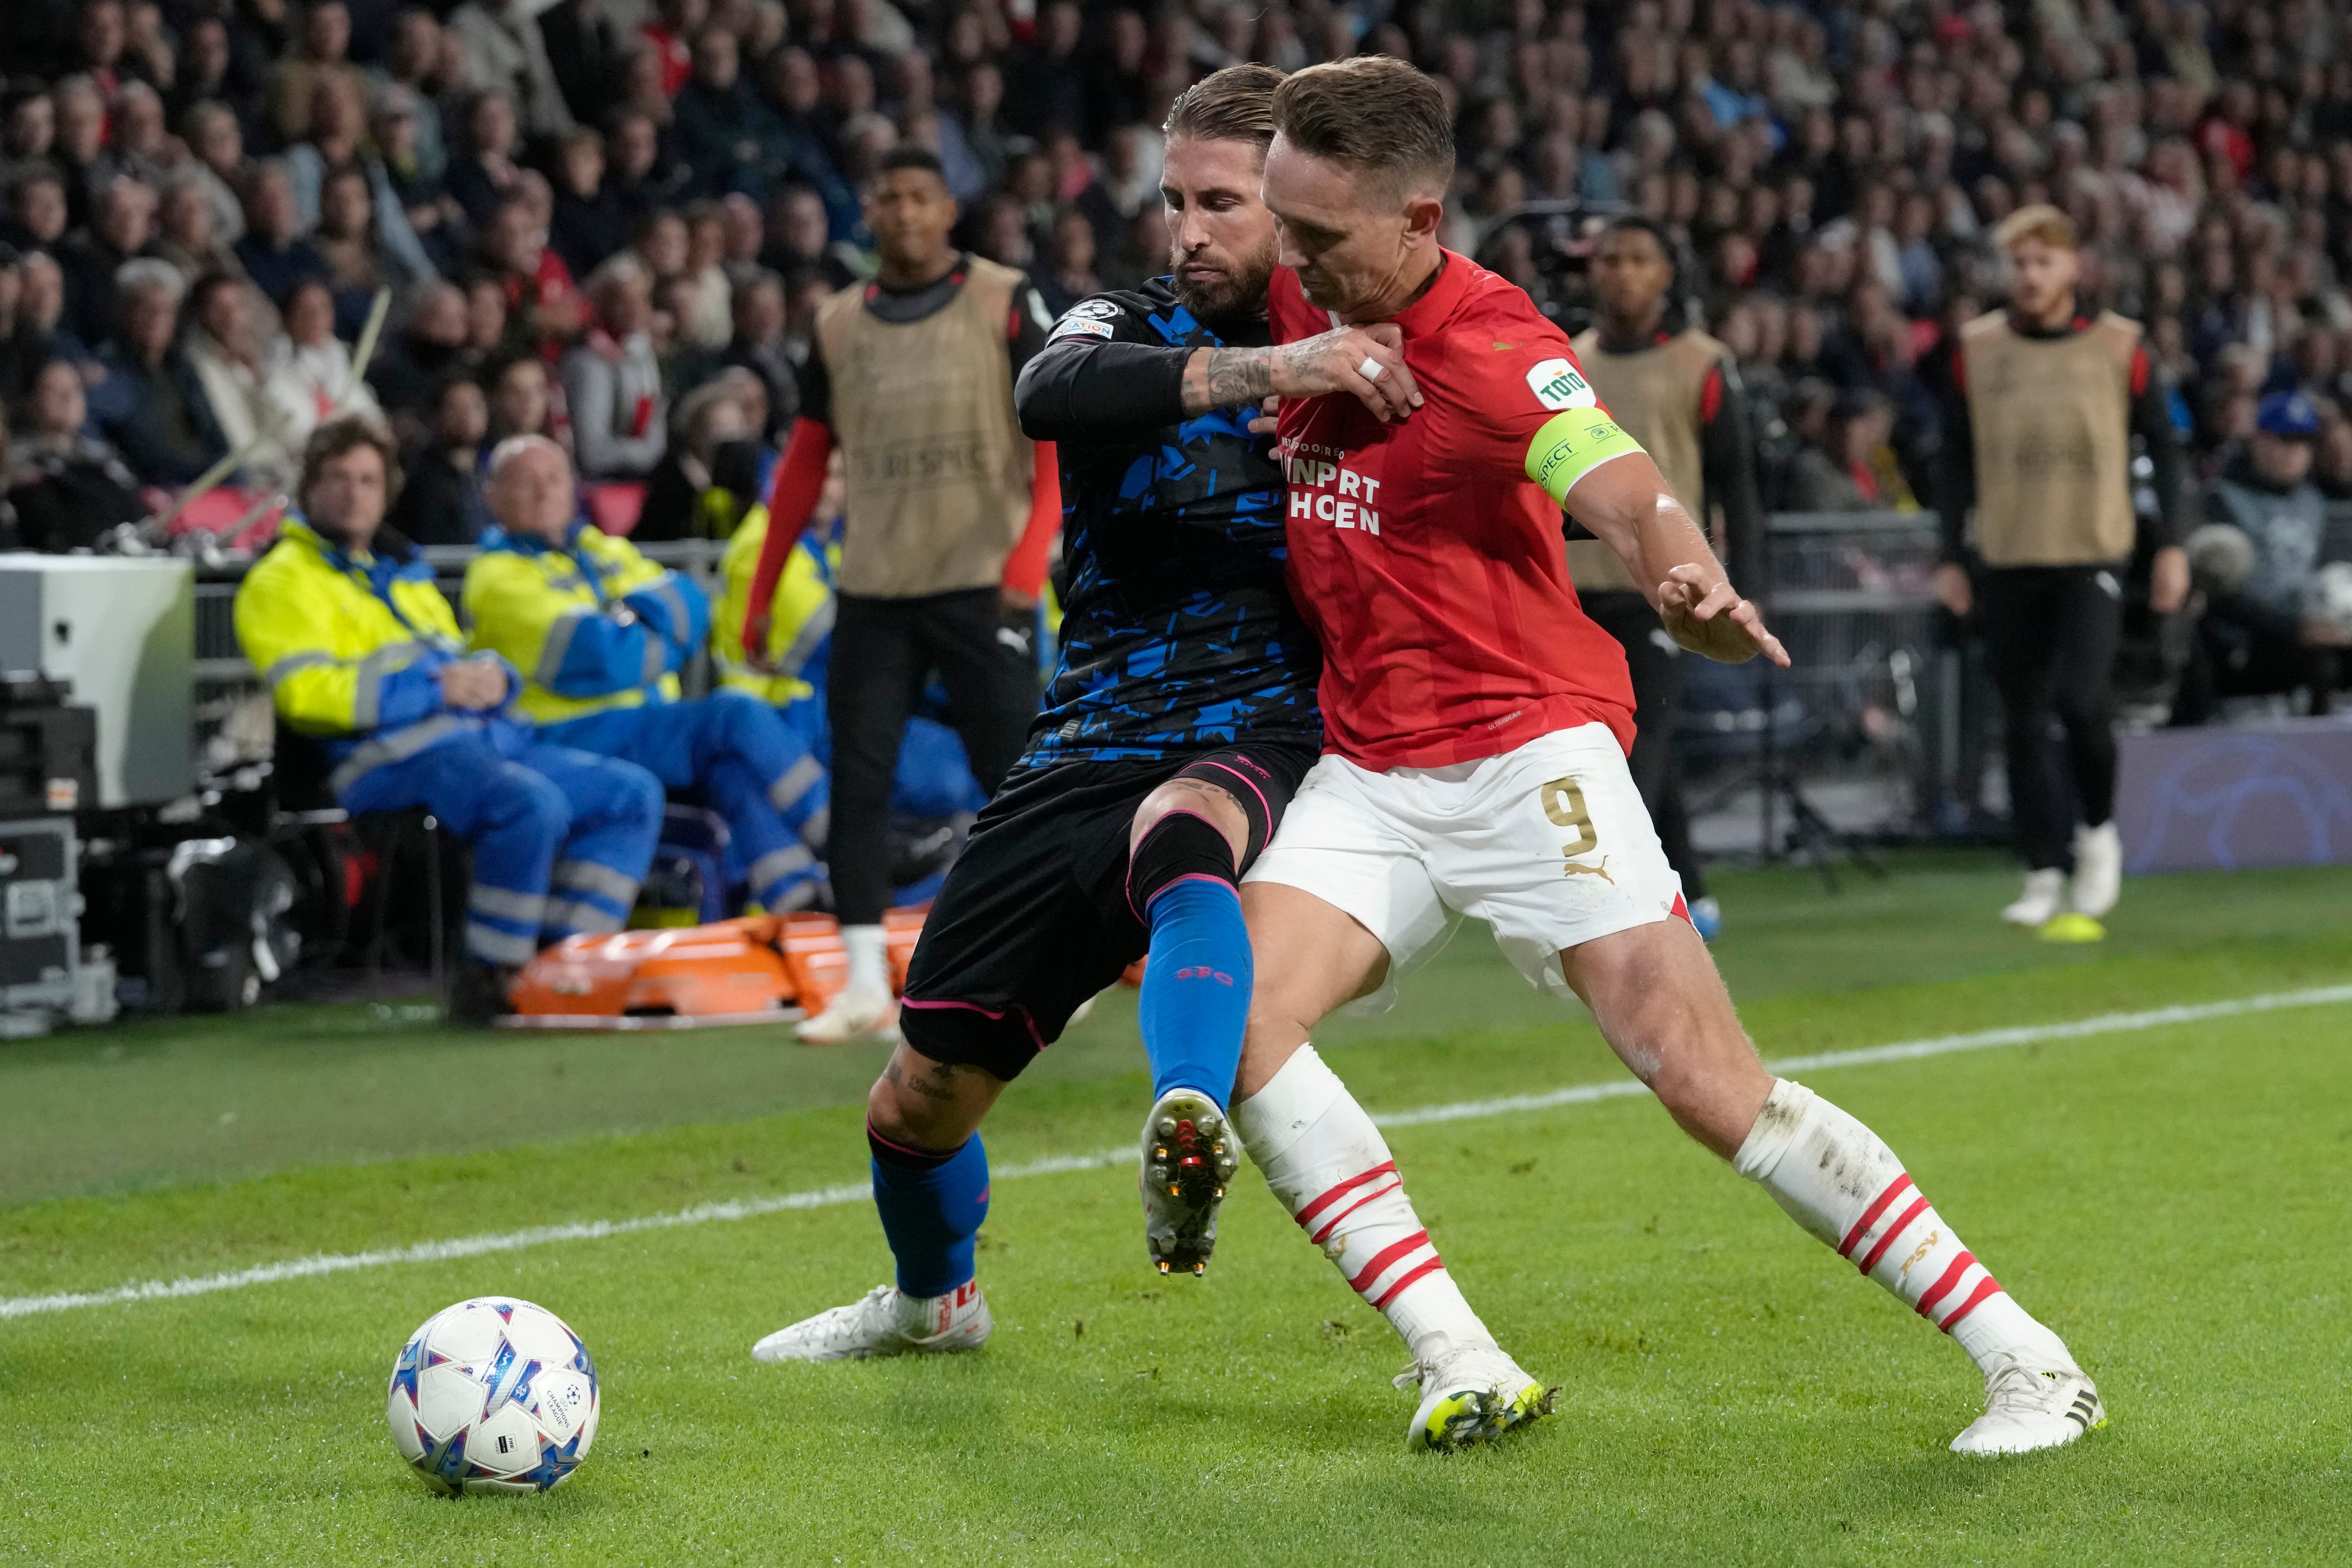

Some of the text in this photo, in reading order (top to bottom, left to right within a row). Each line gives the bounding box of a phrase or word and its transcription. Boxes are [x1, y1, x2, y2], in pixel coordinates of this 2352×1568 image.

[1057, 323, 1110, 334] NDATION
[1540, 372, 1586, 402] TOTO
[1290, 491, 1380, 536] HOEN
[1488, 710, 1522, 730] ULTRAWEAVE
[1541, 777, 1597, 857] 9
[547, 1390, 570, 1428] CHAMPIONS
[547, 1401, 563, 1426] LEAGUE
